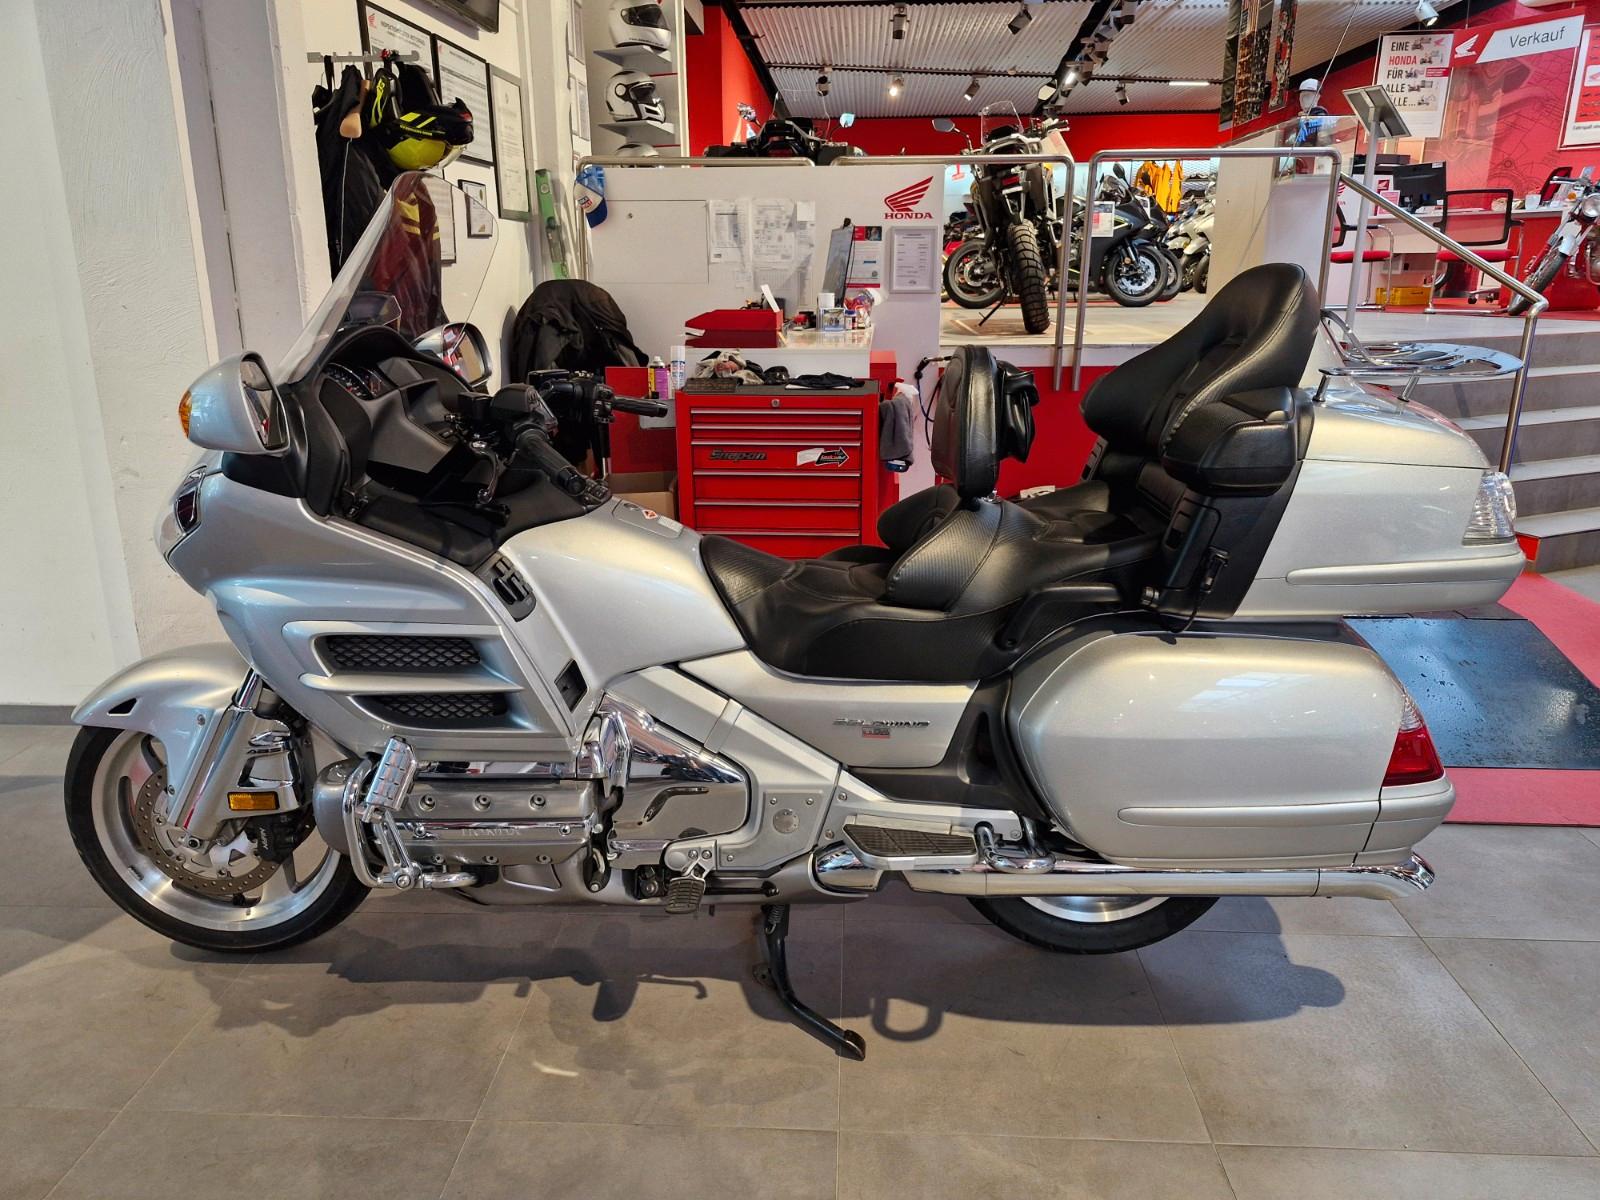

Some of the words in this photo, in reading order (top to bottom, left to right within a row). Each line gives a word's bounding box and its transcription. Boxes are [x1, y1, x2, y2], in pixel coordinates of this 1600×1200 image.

[1510, 25, 1566, 49] Verkauf
[1391, 41, 1410, 52] EINE
[1388, 55, 1417, 66] HONDA
[1387, 67, 1404, 79] FÜR
[1385, 83, 1406, 93] ALLE
[1389, 94, 1416, 106] LLE...
[884, 212, 933, 220] HONDA
